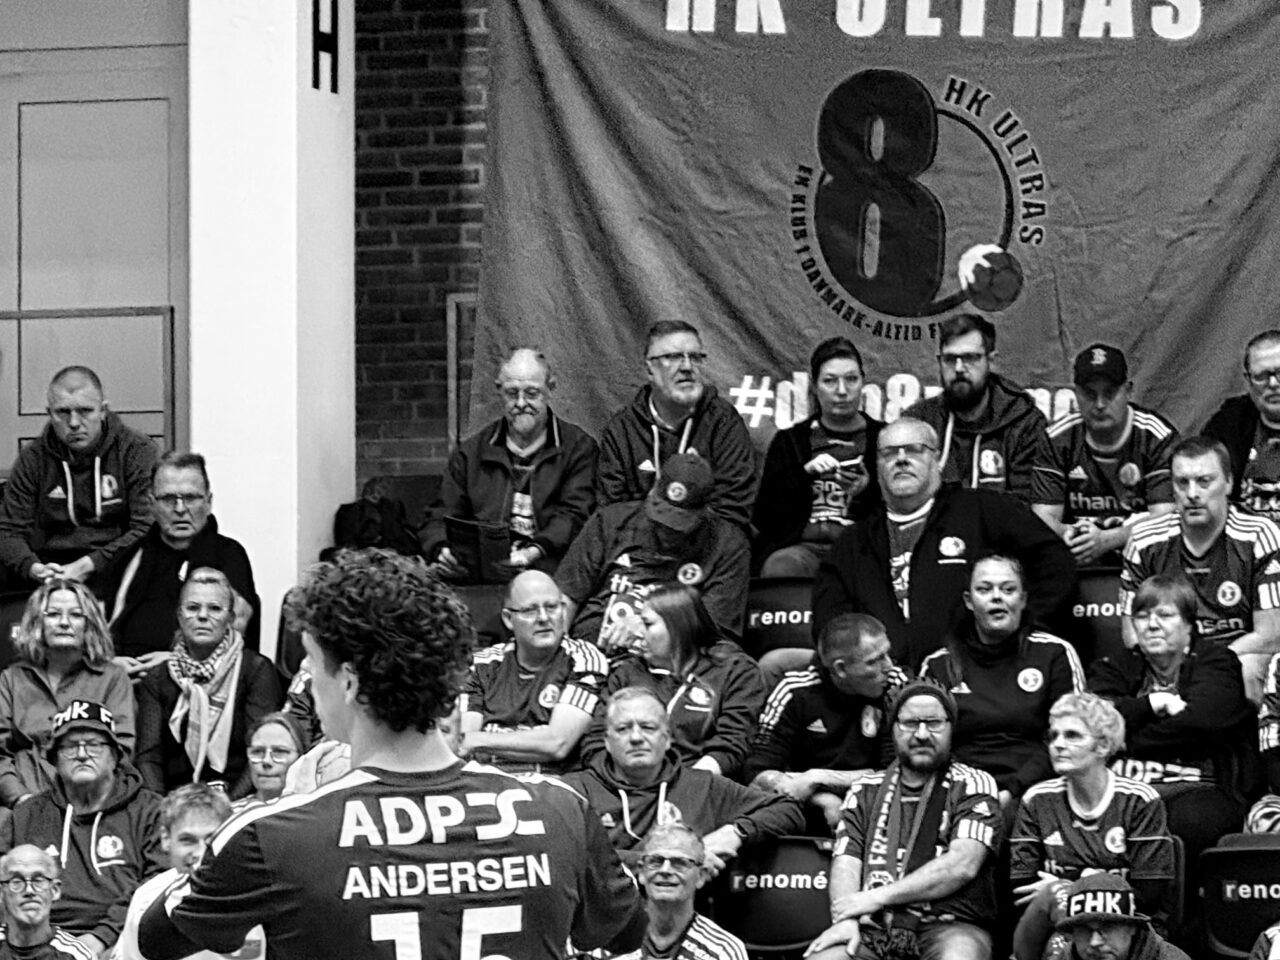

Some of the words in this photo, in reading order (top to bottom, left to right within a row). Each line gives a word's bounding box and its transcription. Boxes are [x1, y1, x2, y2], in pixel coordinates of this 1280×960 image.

[944, 78, 992, 117] HK
[992, 111, 1046, 246] ULTRAS
[342, 853, 552, 900] ANDERSEN
[732, 868, 829, 890] renomé
[1070, 891, 1122, 917] FHK
